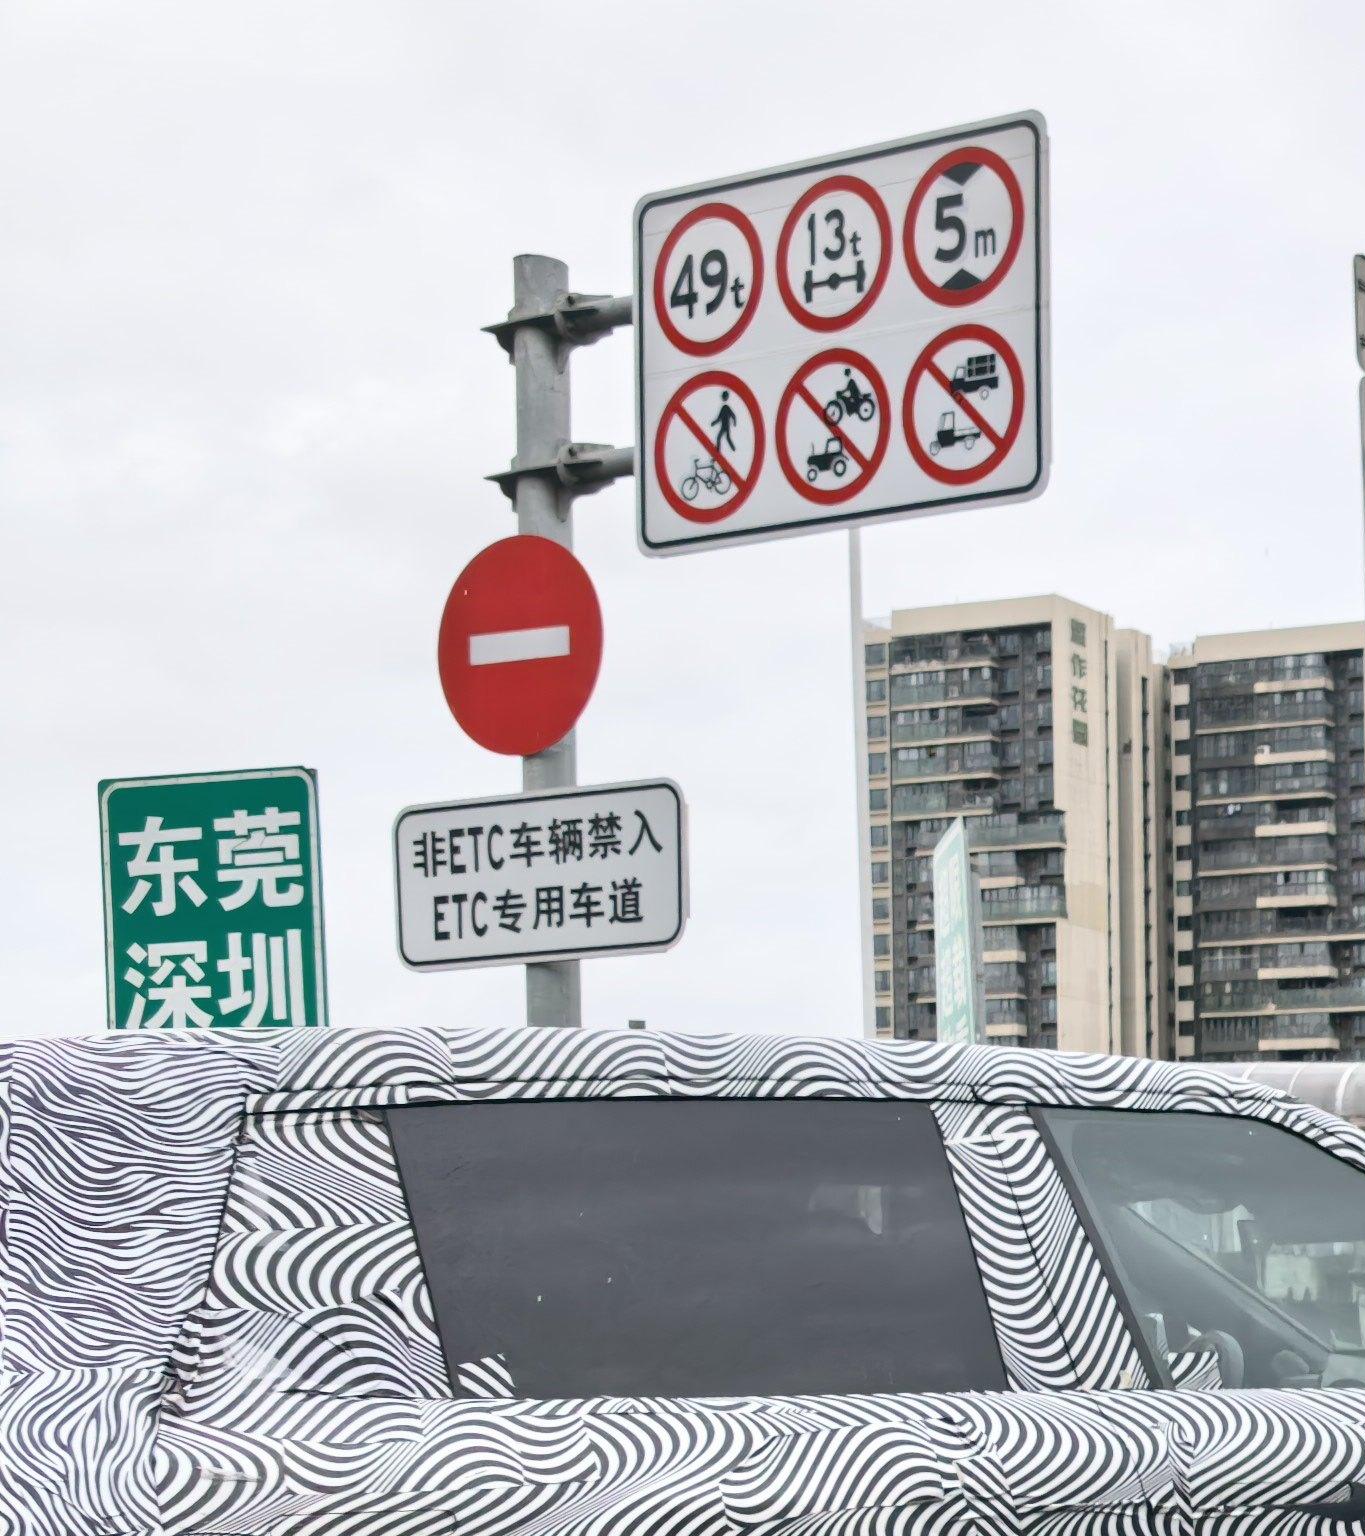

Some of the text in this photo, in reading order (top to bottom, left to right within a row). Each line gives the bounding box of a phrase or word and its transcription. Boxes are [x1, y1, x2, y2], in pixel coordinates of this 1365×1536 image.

[806, 209, 862, 266] 13t
[670, 248, 746, 319] 49t
[118, 806, 305, 917] 东莞
[413, 809, 663, 878] 非ETC车辆禁入
[433, 877, 644, 941] ETC专用车道
[123, 928, 306, 1029] 深圳
